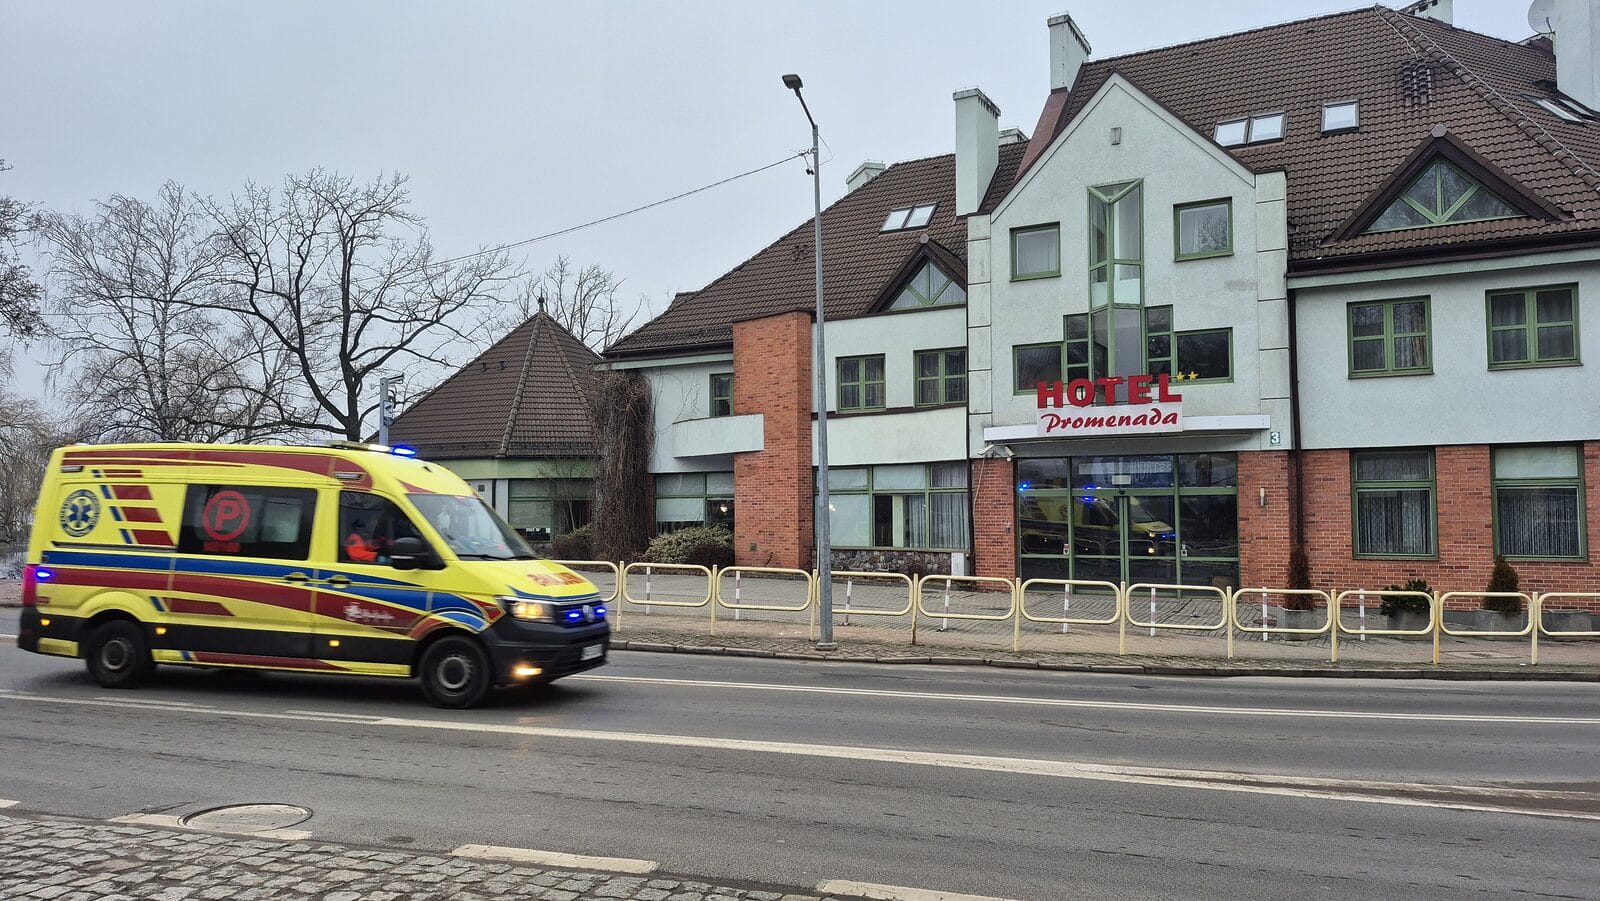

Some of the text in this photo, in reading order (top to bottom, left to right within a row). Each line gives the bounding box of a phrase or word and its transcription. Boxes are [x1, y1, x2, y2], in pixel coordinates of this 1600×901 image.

[1037, 373, 1182, 408] HOTEL
[1040, 407, 1179, 433] Promenada
[1271, 432, 1280, 444] 3
[214, 500, 241, 530] P
